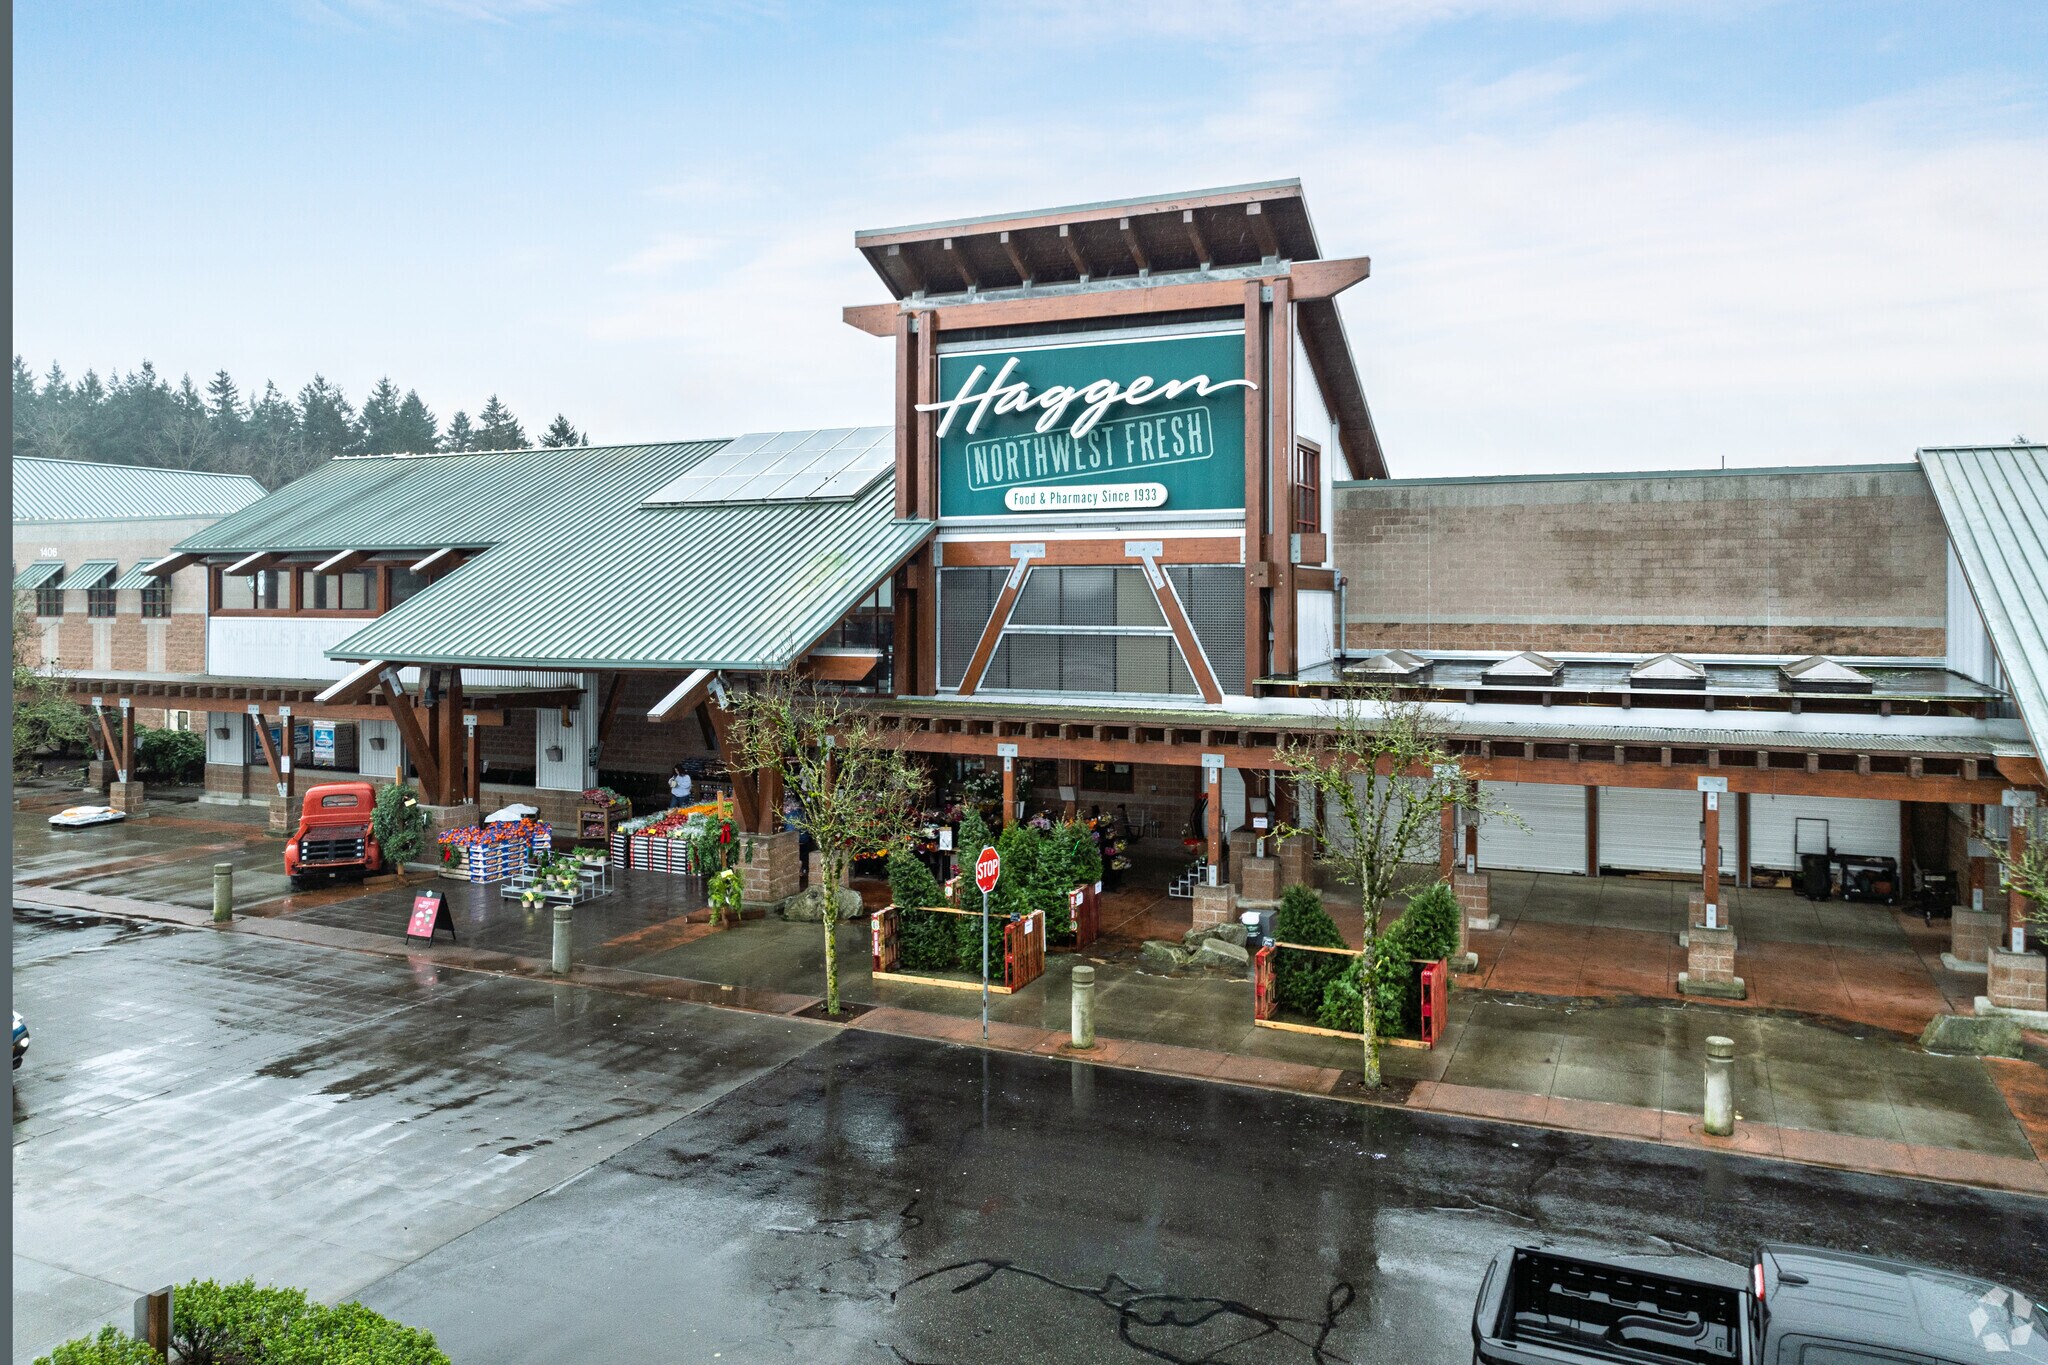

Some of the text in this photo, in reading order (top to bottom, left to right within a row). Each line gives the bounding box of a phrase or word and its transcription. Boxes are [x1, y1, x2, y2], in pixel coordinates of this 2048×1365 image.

[914, 356, 1259, 439] Haggen
[973, 412, 1203, 485] NORTHWEST FRESH
[1014, 488, 1157, 506] Food & Pharmacy Since 1933
[40, 547, 58, 558] 1406
[977, 858, 998, 880] STOP
